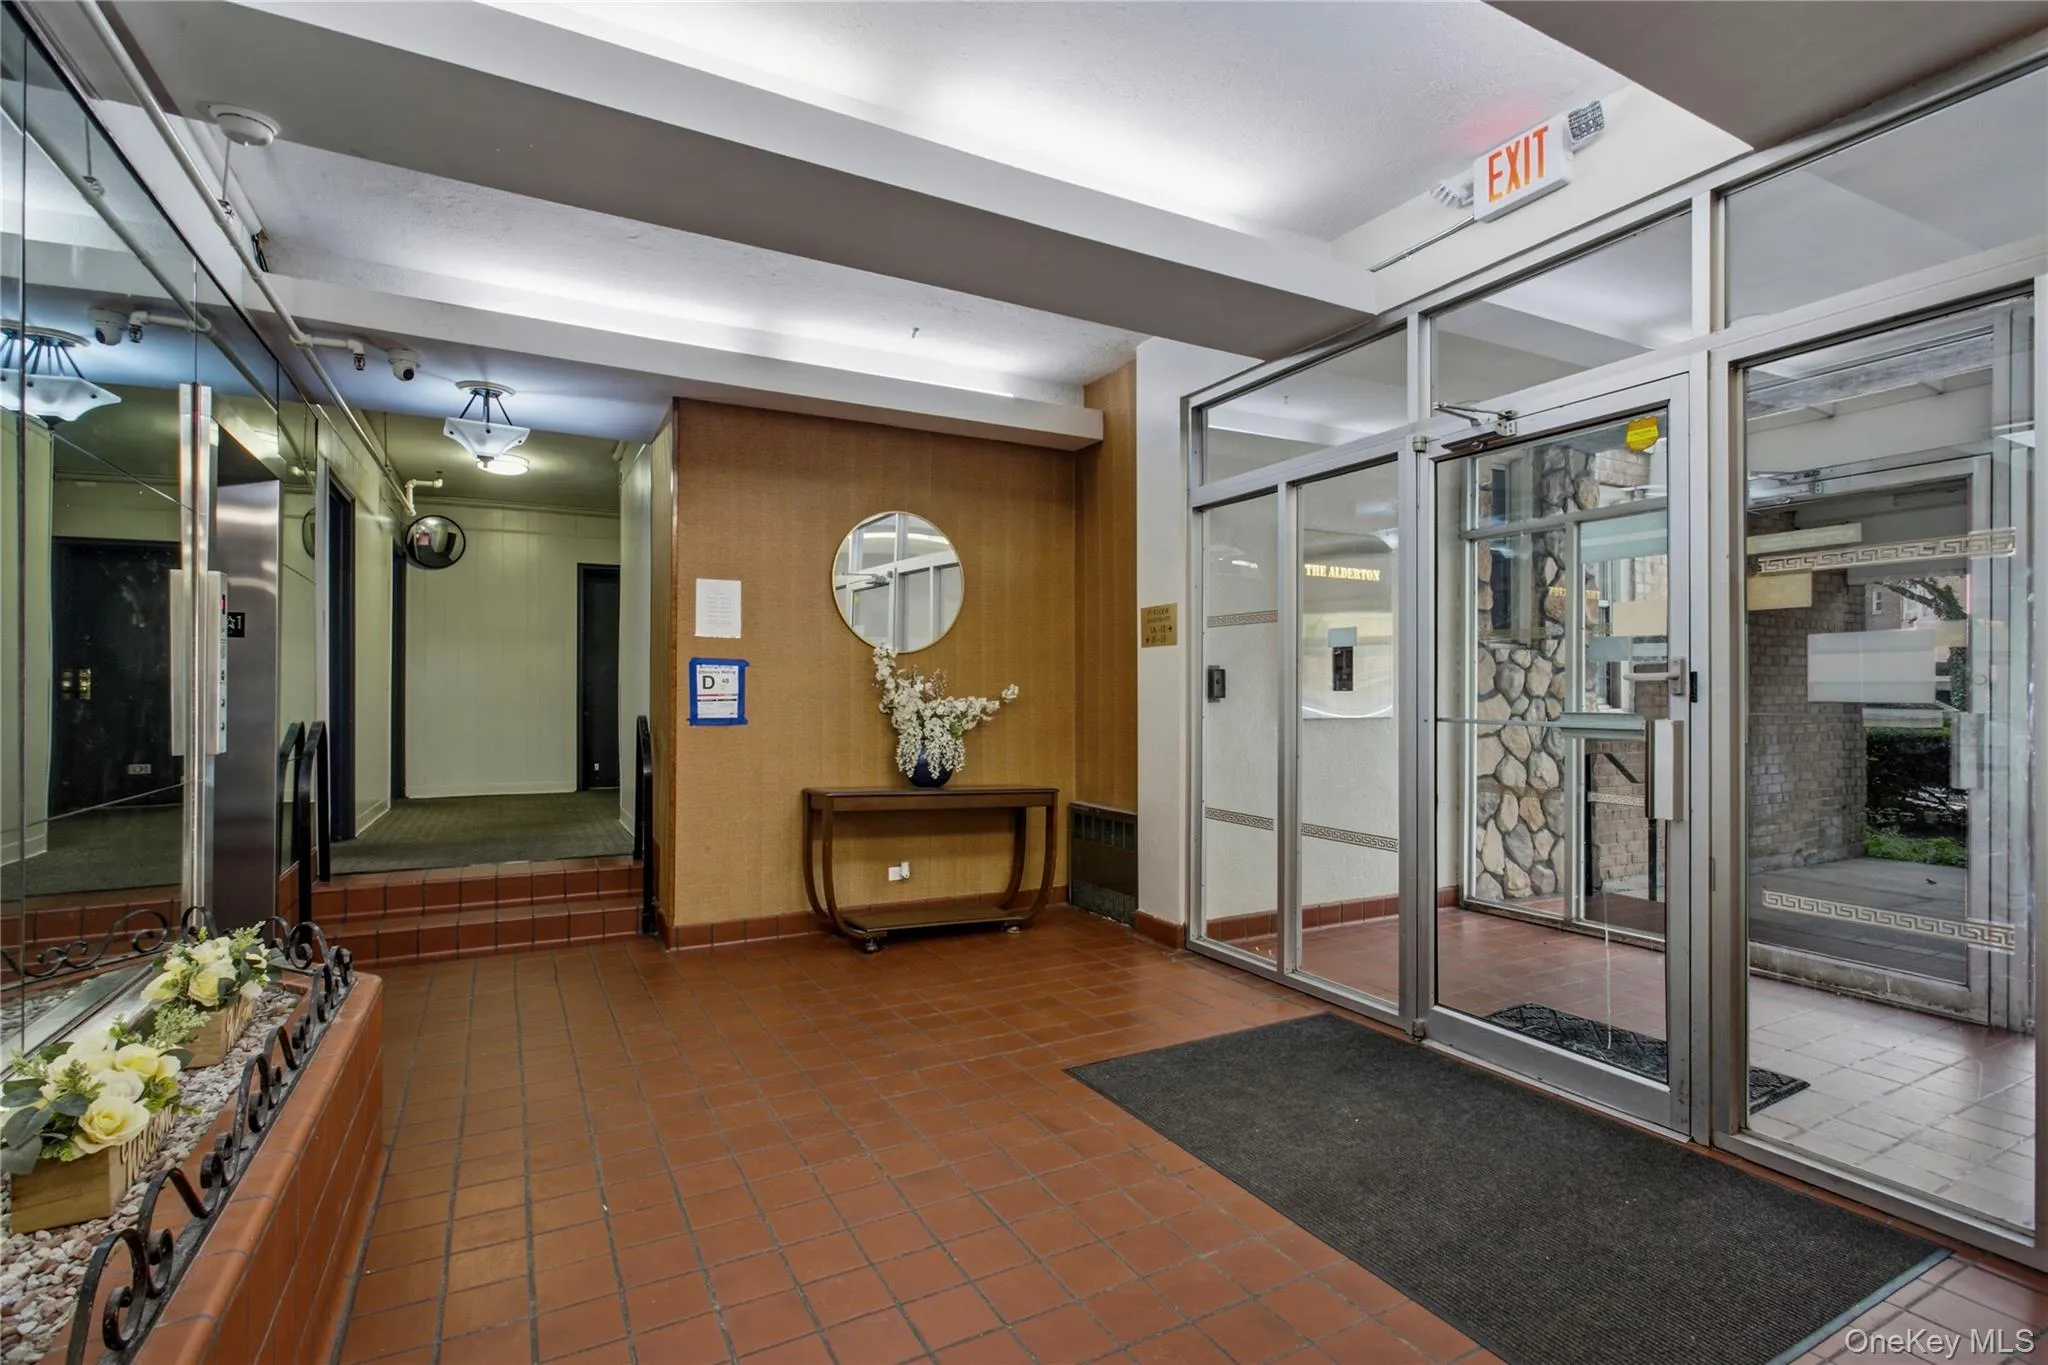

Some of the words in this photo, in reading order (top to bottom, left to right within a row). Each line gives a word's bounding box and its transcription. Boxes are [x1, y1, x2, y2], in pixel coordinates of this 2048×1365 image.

[1488, 124, 1549, 203] EXIT
[1304, 563, 1327, 577] THE
[703, 675, 715, 690] D
